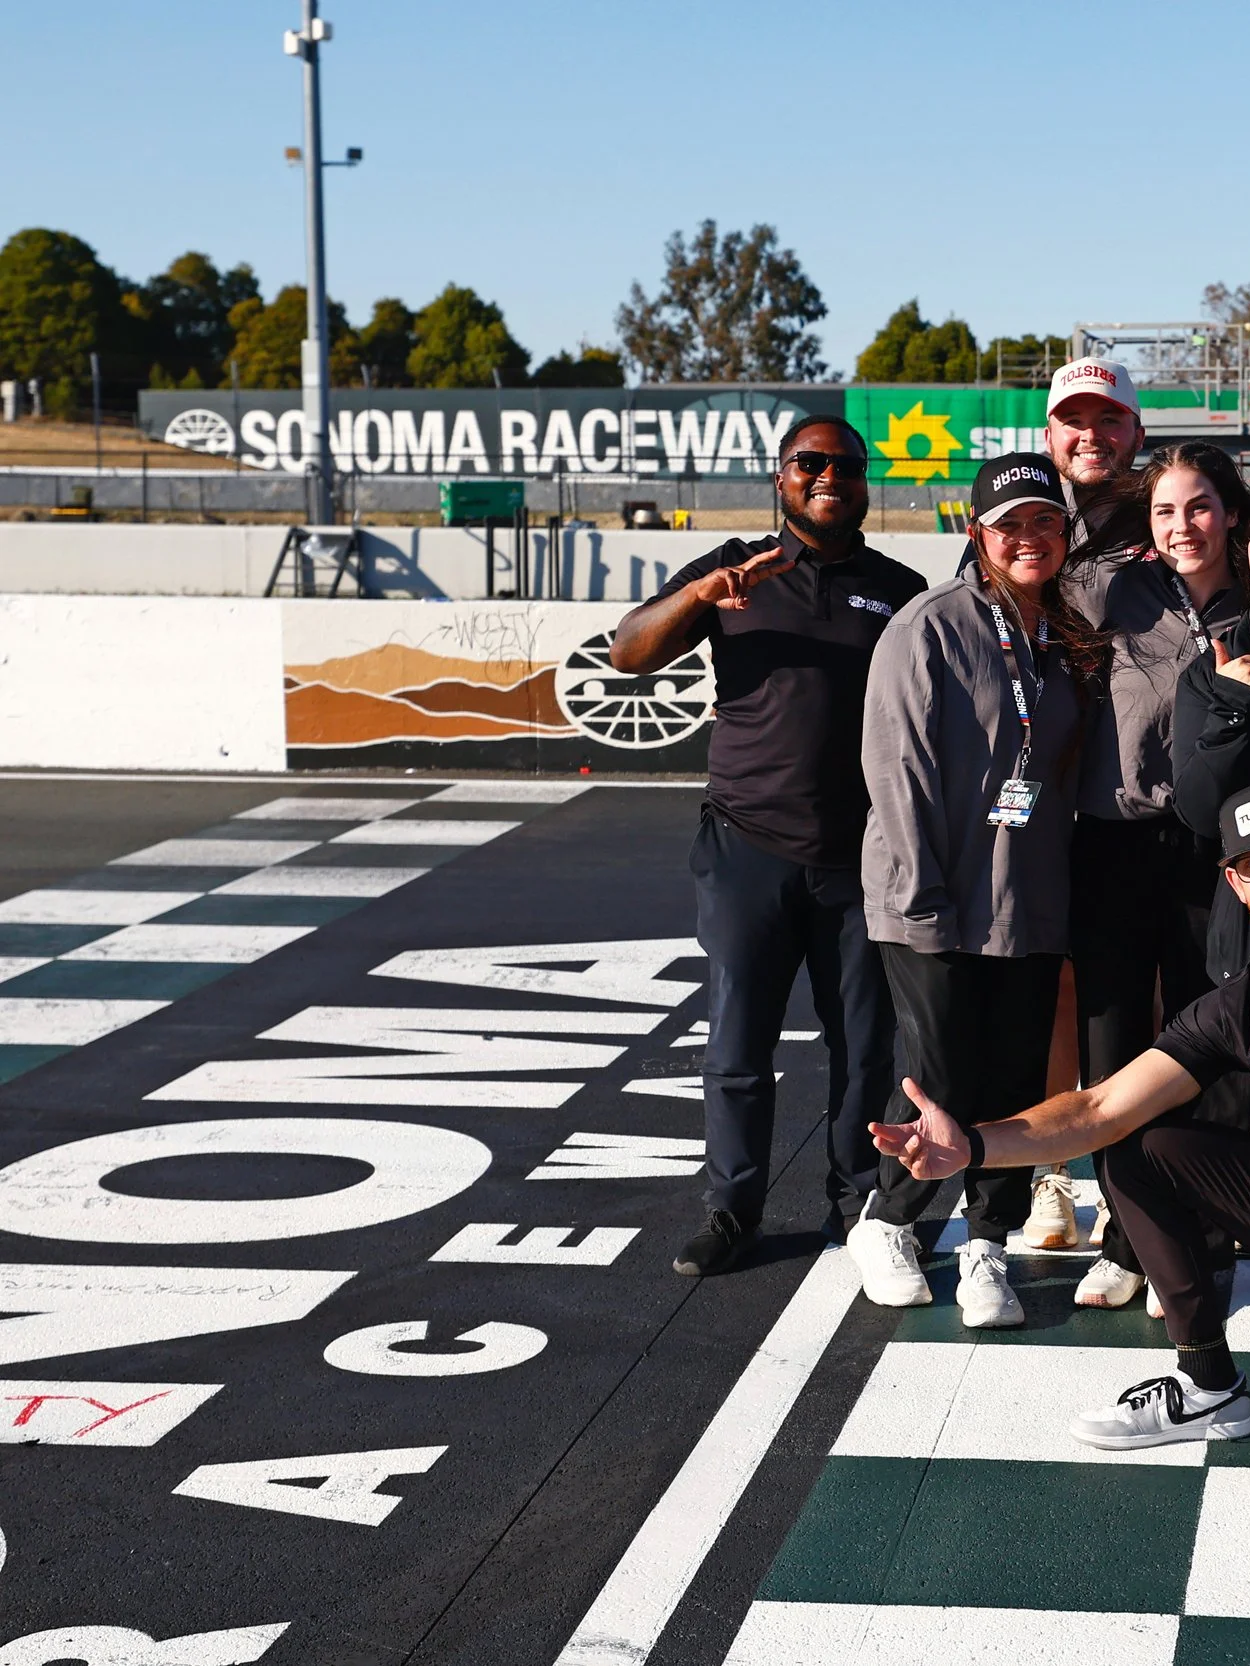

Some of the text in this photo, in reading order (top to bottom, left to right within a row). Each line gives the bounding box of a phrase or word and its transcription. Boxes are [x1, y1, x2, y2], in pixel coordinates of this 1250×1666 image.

[1061, 365, 1117, 387] BRISTOL
[240, 408, 796, 474] SONOMA RACEWAY
[992, 466, 1049, 492] NASCAR
[866, 605, 894, 617] RACEWA
[991, 604, 1011, 639] NASCAR
[1012, 680, 1028, 714] NASCAR
